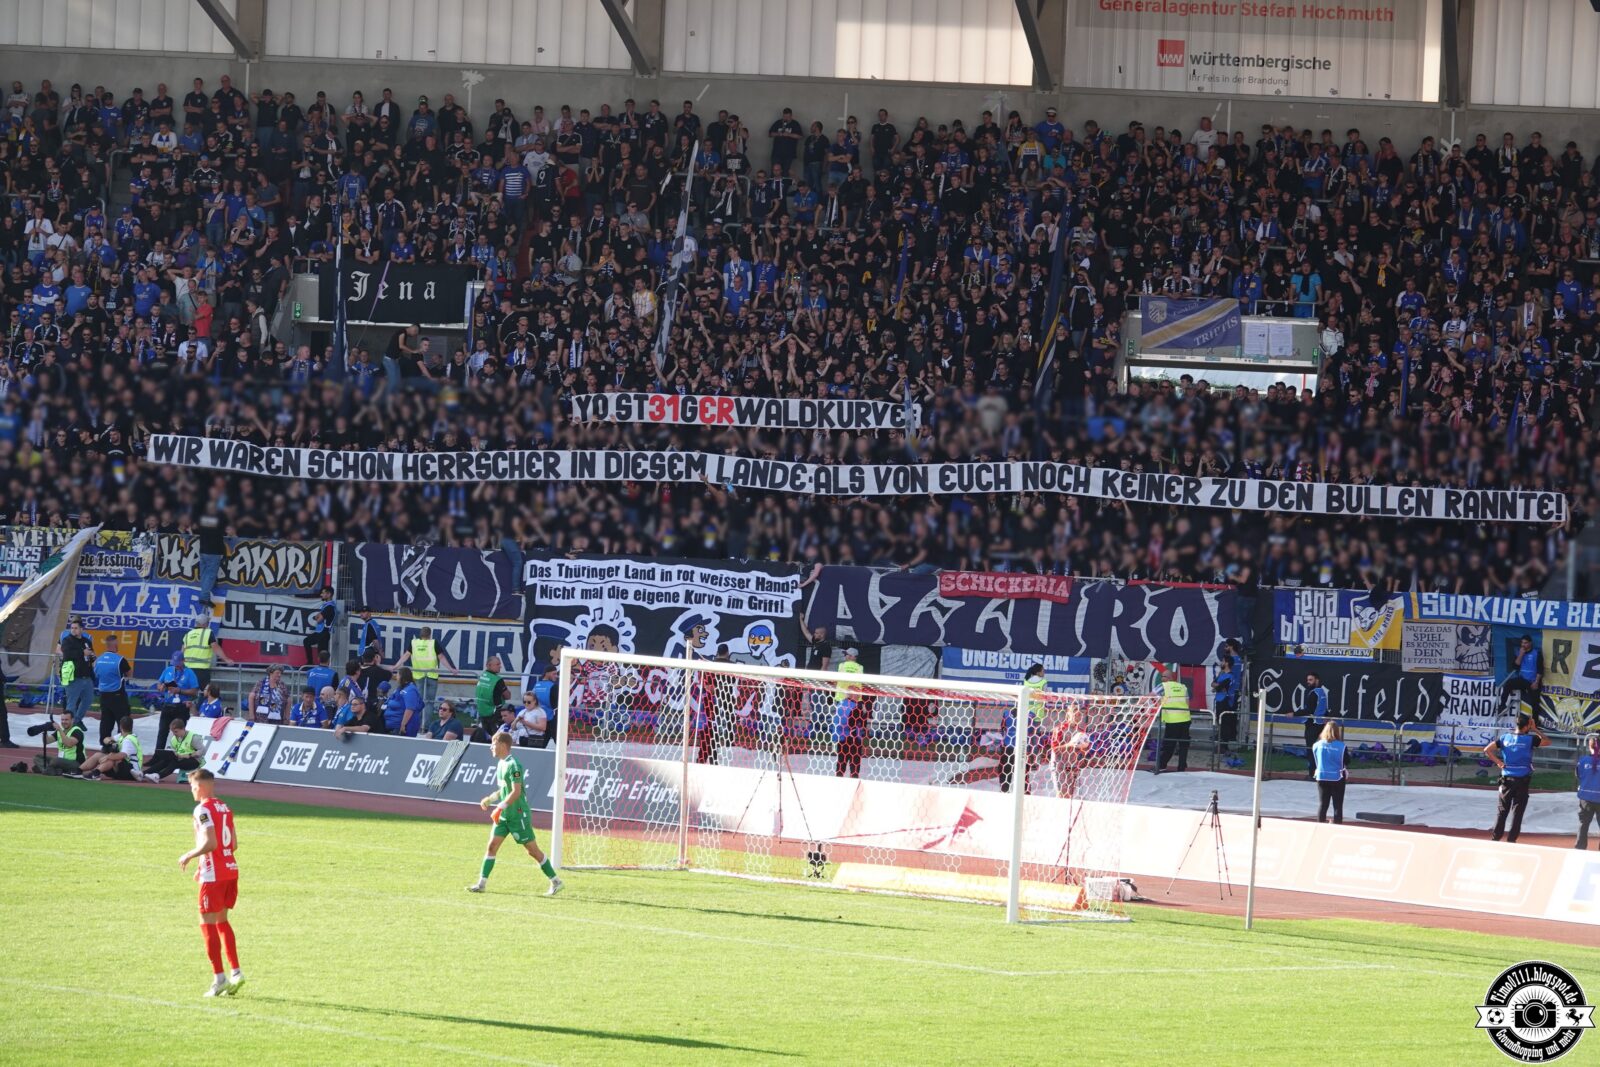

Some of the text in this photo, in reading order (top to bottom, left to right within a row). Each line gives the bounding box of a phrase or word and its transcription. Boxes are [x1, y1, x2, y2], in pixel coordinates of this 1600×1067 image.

[1099, 0, 1394, 22] Generalagentur Stefan Hochmuth
[1189, 51, 1332, 72] württembergische
[1189, 73, 1291, 87] Ihr Fels in der Brandung.
[348, 271, 436, 302] Jena
[153, 436, 203, 466] WIR
[209, 440, 300, 477] WAREN
[307, 450, 394, 481] SCHON
[401, 452, 561, 481] HERRSCHER
[570, 451, 596, 478] IN
[604, 452, 706, 480] DIESEM
[814, 466, 865, 494] ALS
[873, 466, 929, 494] VON
[939, 464, 1012, 492] EUCH
[1021, 463, 1091, 494] NOCH
[1101, 471, 1201, 507] KEINER
[1210, 479, 1247, 508] ZU
[1257, 481, 1314, 511] DEN
[1326, 485, 1433, 516] BULLEN
[1448, 489, 1563, 521] RANNTE!
[97, 552, 143, 570] Festung
[159, 536, 320, 585] HAAKIRI
[530, 563, 798, 594] Das Thüringer Land in rot weisser Hand?
[940, 573, 1069, 598] SCHICKERIA
[539, 584, 784, 614] Nicht mal die eigene Kurve im Griff!
[1422, 592, 1560, 626] SÜDKURVE
[222, 603, 322, 635] ULTRAS
[1280, 614, 1350, 644] branco
[1413, 633, 1445, 642] SPIEL
[1417, 641, 1450, 649] KÖNNTE
[962, 649, 1069, 671] UNBEUGSAM
[1404, 657, 1437, 665] LETZTES
[1414, 649, 1443, 657] DEIN
[277, 746, 389, 776] SWE Für Erfurt.
[412, 759, 436, 780] SW
[454, 763, 482, 783] Für
[222, 814, 231, 847] 6
